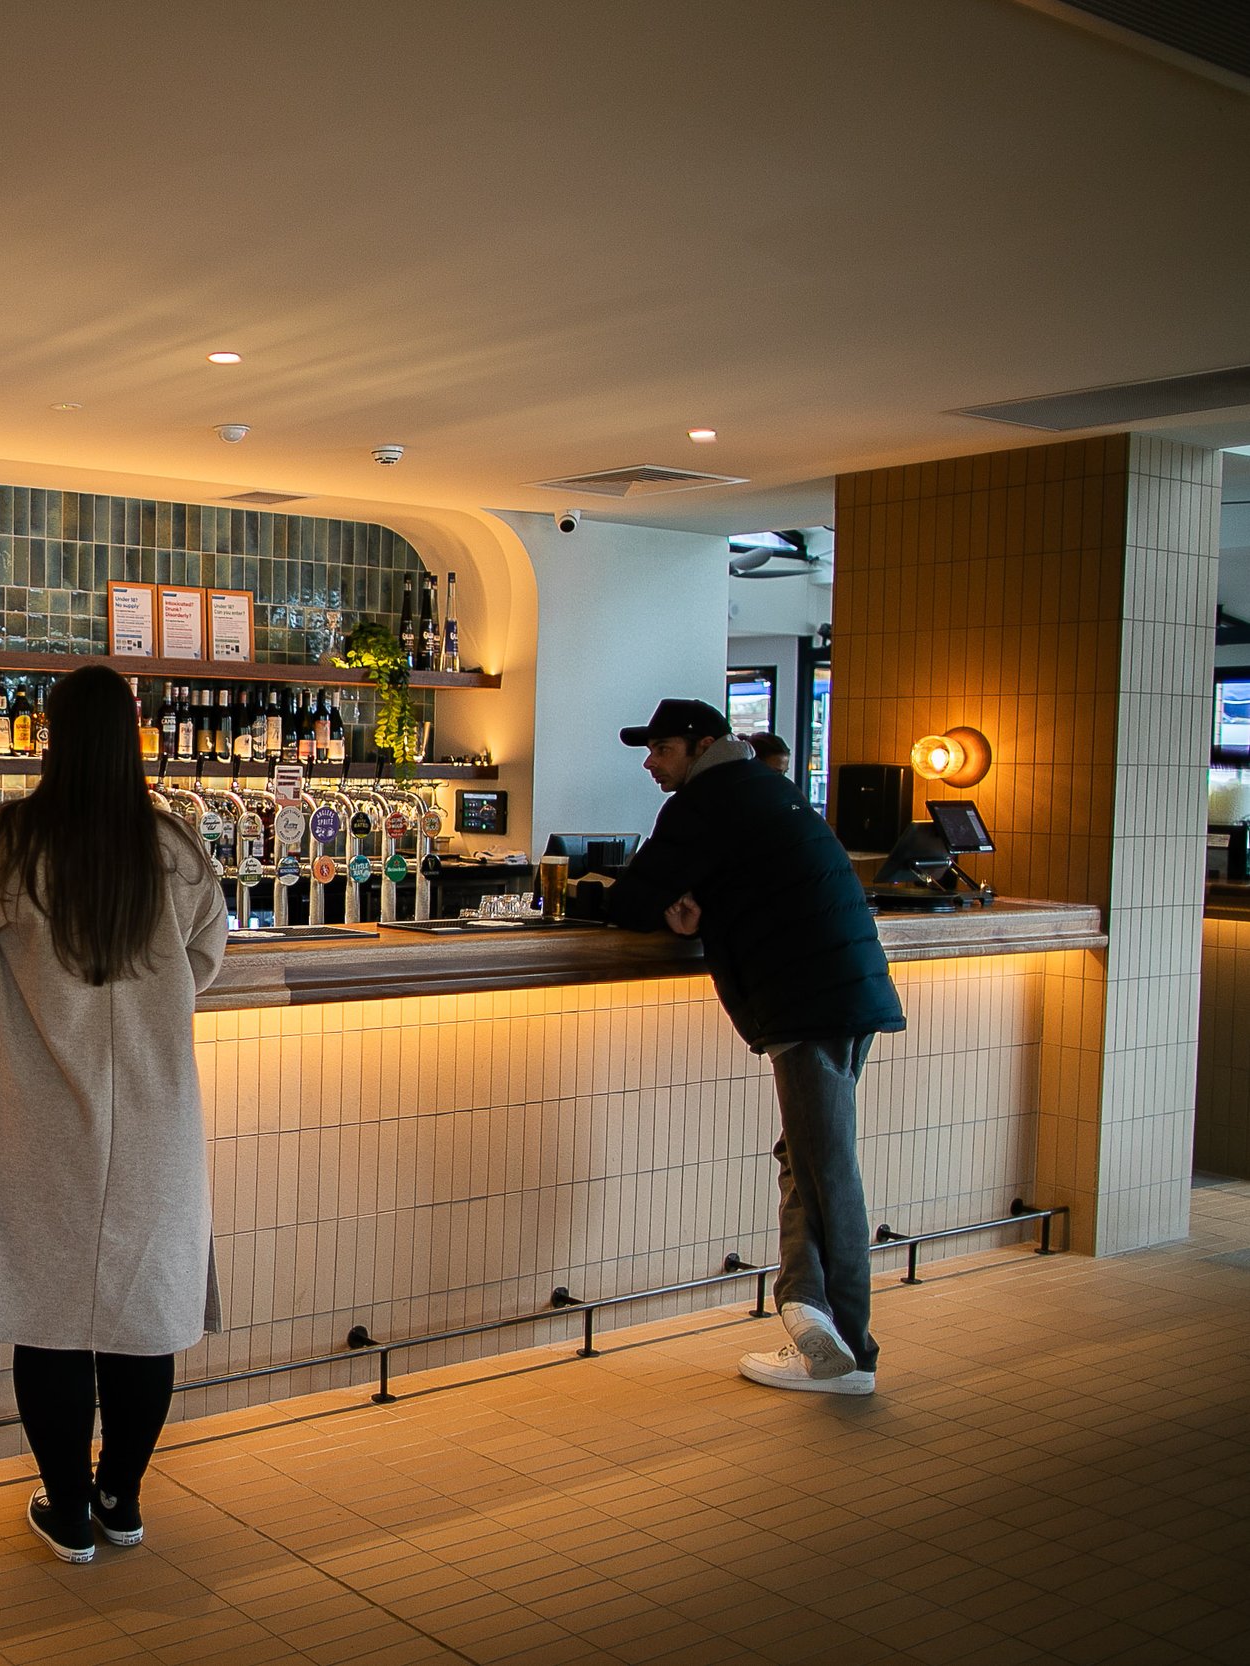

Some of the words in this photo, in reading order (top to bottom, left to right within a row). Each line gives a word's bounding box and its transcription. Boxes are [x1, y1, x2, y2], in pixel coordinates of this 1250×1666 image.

[165, 611, 192, 619] Disorderly?
[316, 809, 335, 819] ANGLERS
[317, 818, 334, 826] SPRITZ
